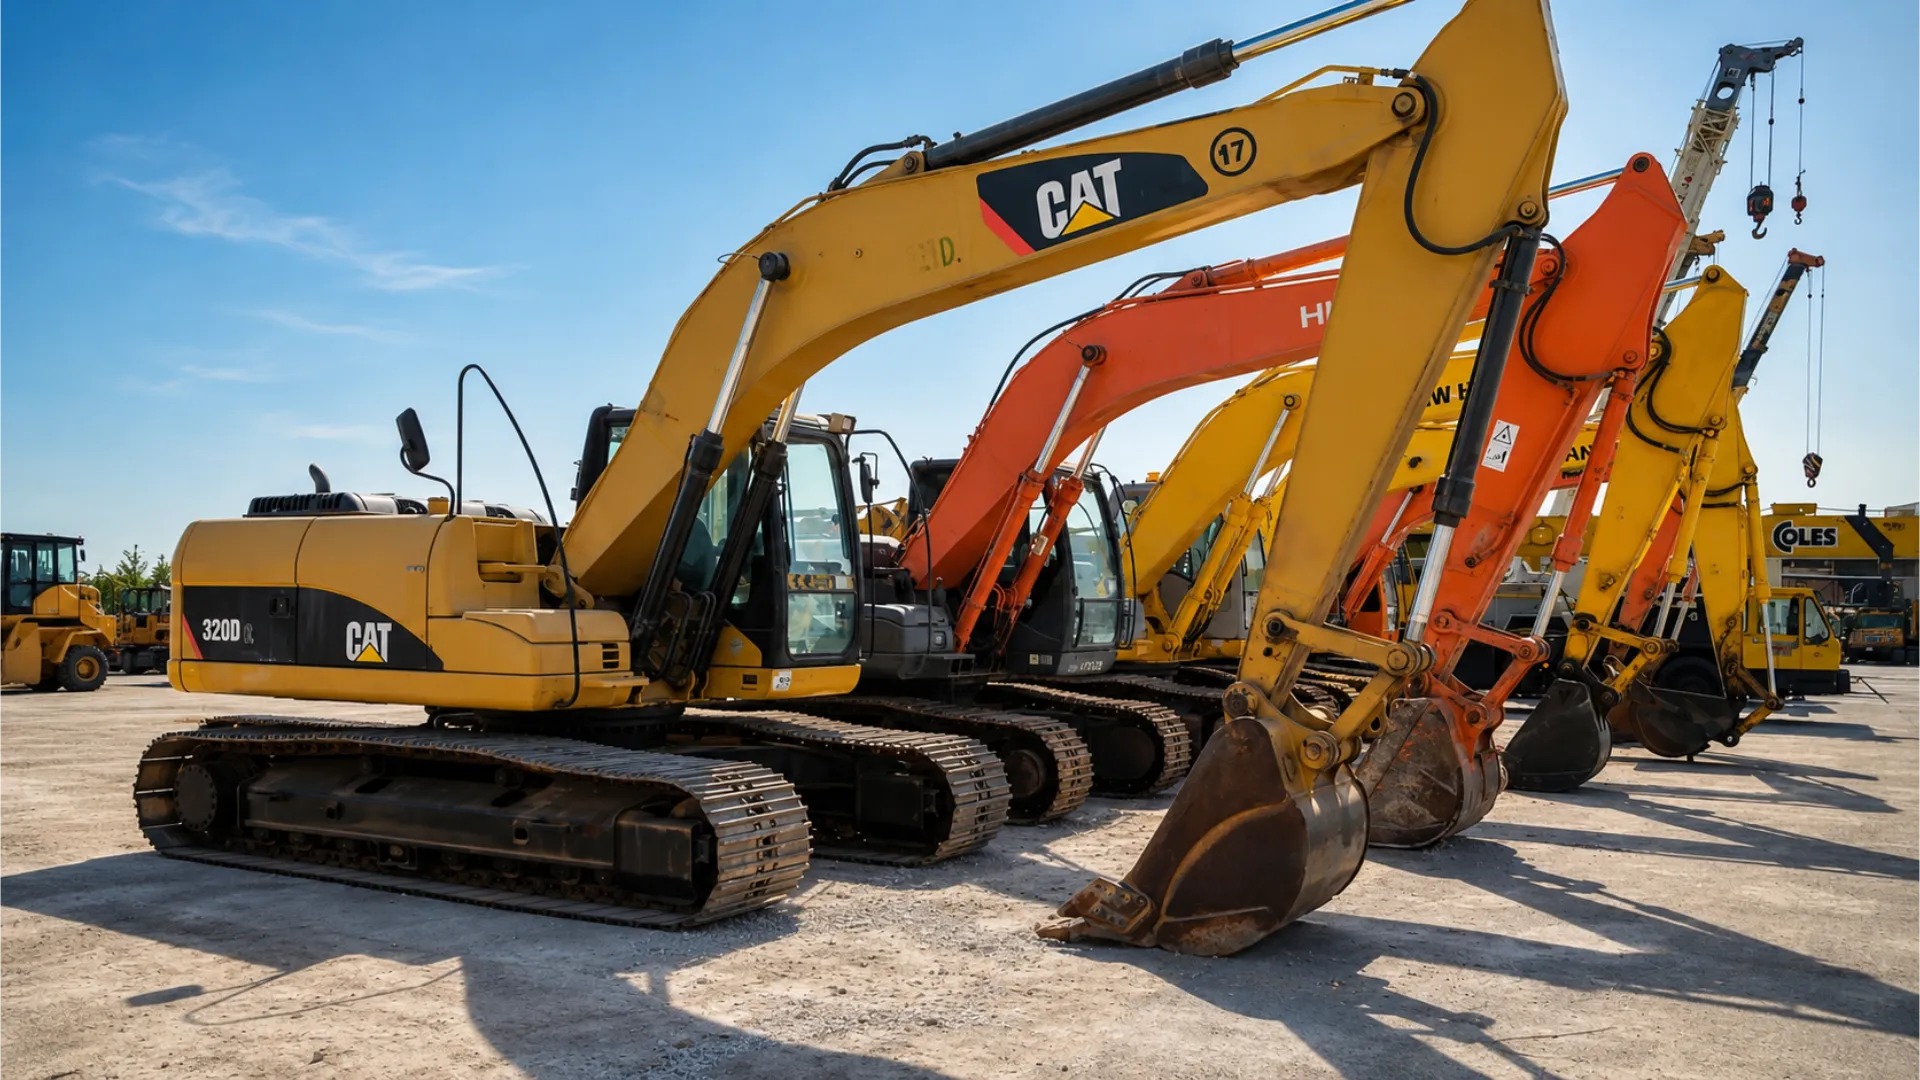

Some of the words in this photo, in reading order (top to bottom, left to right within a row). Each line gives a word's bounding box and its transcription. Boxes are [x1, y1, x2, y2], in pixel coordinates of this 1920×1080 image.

[1218, 139, 1245, 166] 17
[1036, 157, 1122, 240] CAT
[1426, 385, 1451, 407] W
[1772, 520, 1838, 555] COLES
[202, 618, 241, 642] 320D
[346, 621, 393, 663] CAT
